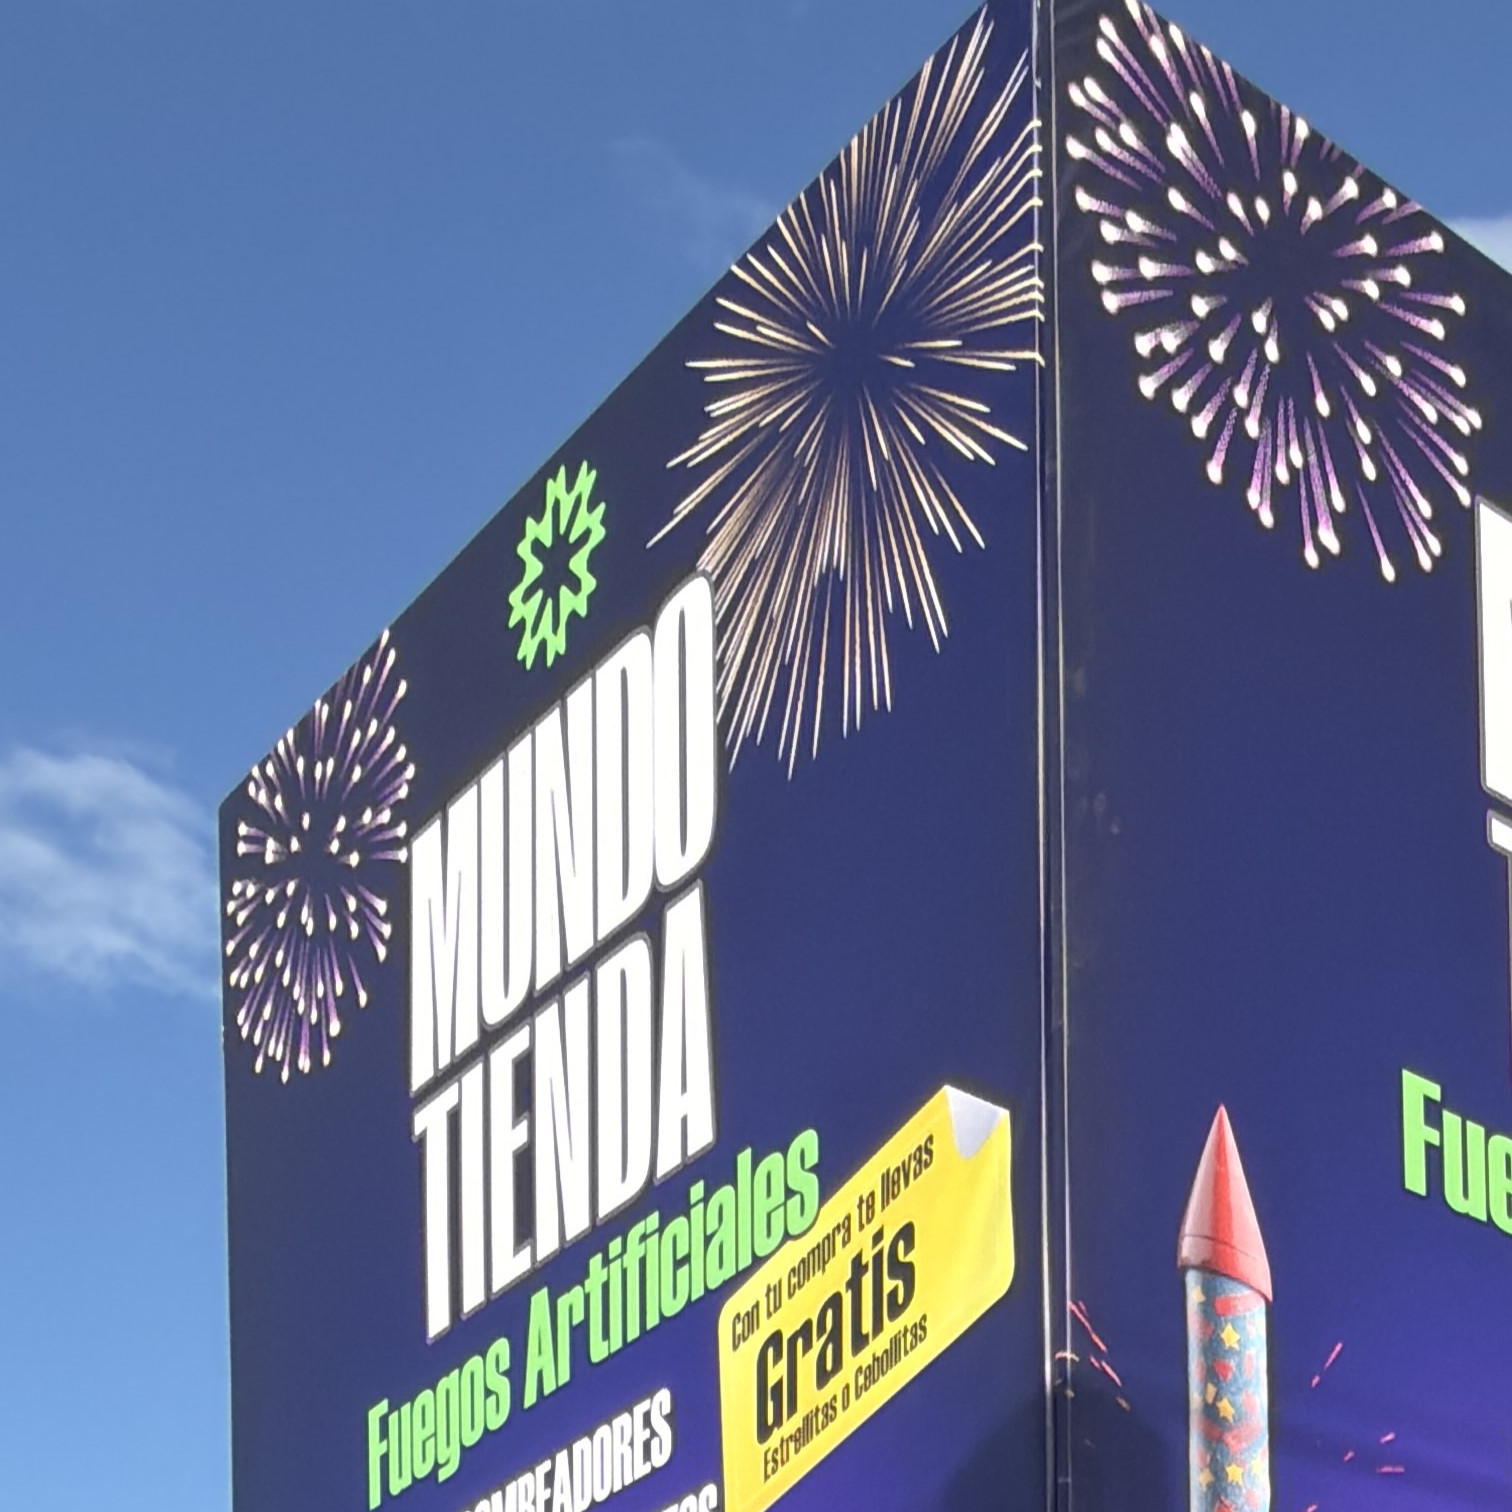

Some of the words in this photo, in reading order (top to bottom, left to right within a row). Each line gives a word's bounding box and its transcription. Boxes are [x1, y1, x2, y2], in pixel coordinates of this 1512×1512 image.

[410, 572, 716, 1096] MUNDO
[412, 879, 716, 1343] TIENDA
[732, 1299, 760, 1352] Con
[765, 1278, 782, 1319] tu
[787, 1212, 852, 1300] compra
[857, 1190, 875, 1231] te
[880, 1134, 934, 1213] llevas
[368, 1346, 512, 1509] Fuegos
[523, 1129, 820, 1411] Artificiales
[756, 1220, 916, 1445] Gratis
[763, 1397, 837, 1483] Estrellitas
[841, 1382, 851, 1412] o
[854, 1313, 928, 1401] Cebollitas
